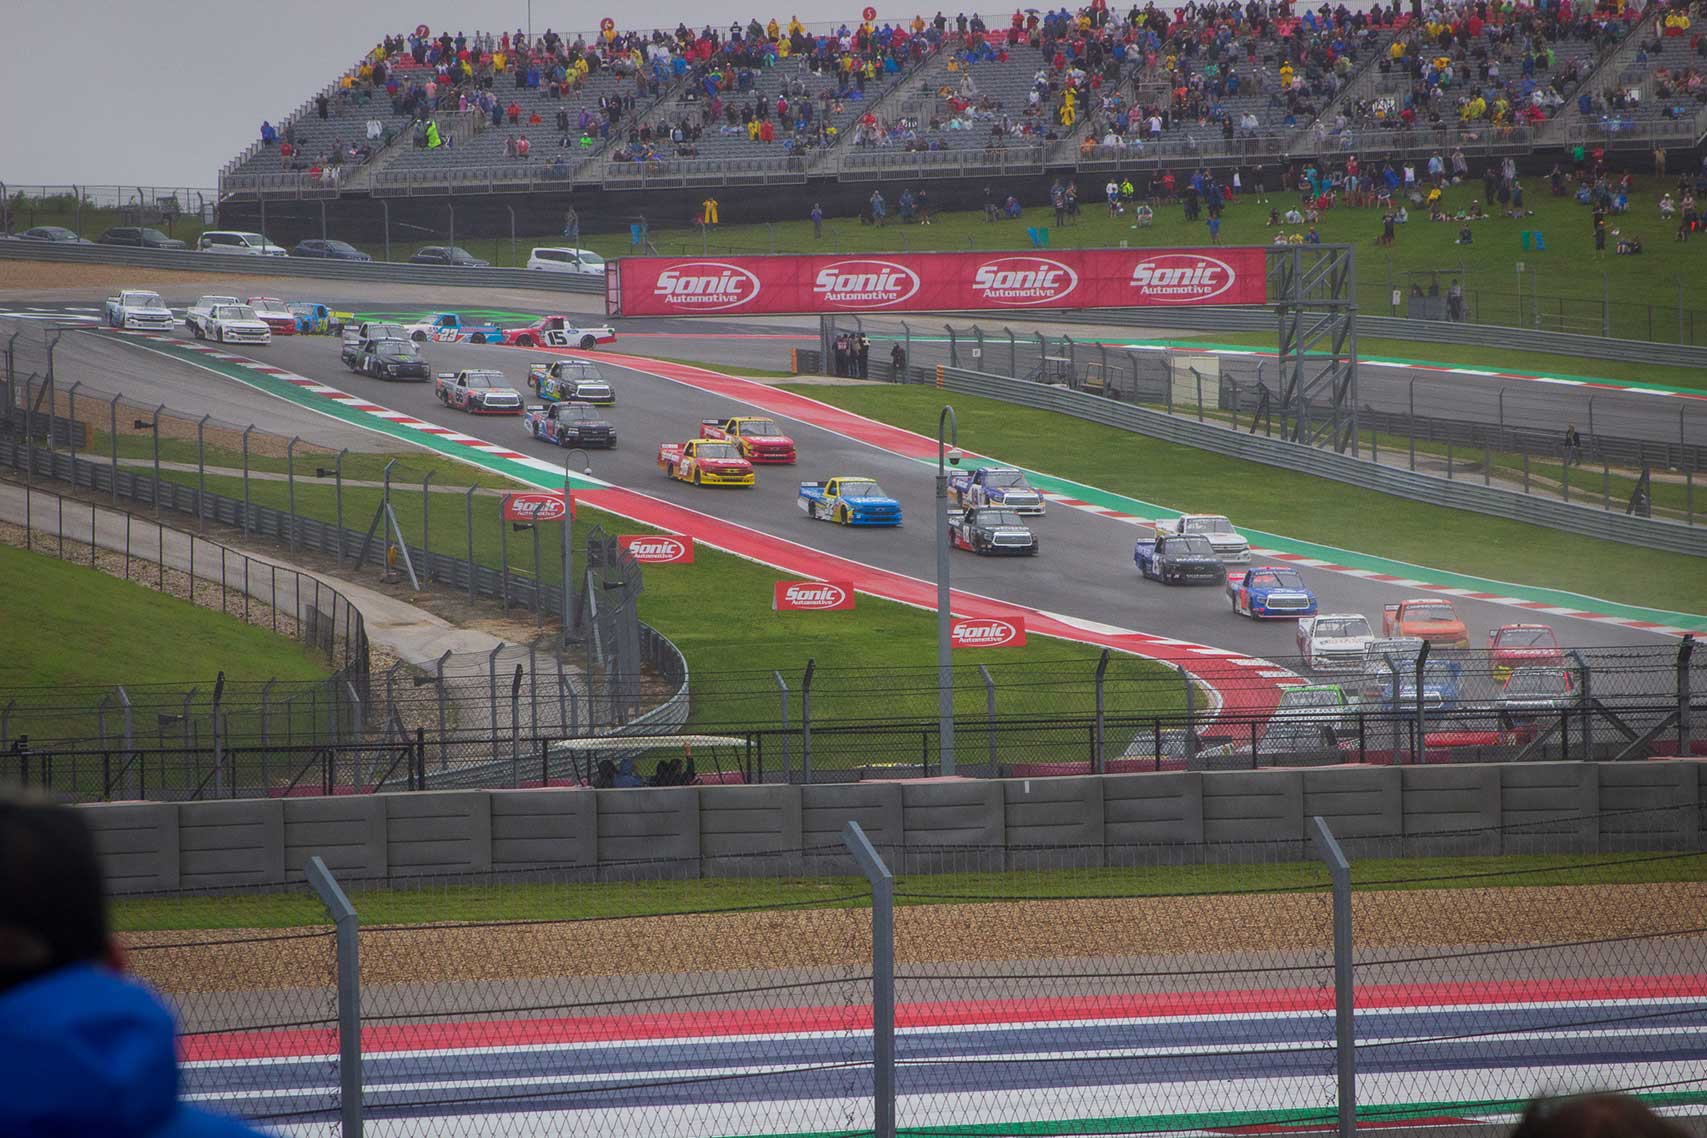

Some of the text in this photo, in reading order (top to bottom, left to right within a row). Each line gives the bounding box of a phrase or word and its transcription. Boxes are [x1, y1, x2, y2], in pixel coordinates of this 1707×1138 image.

[813, 268, 906, 292] Sonic
[972, 265, 1064, 289] Sonic
[1130, 262, 1221, 286] Sonic
[654, 271, 746, 294] Sonic
[1140, 285, 1212, 294] Automotive
[665, 294, 737, 303] Automotive
[824, 291, 896, 300] Automotive
[983, 288, 1054, 297] Automotive
[440, 328, 458, 342] 23
[546, 331, 567, 345] 15
[629, 541, 677, 554] Sonic
[785, 587, 837, 600] Sonic
[952, 623, 1007, 638] Sonic
